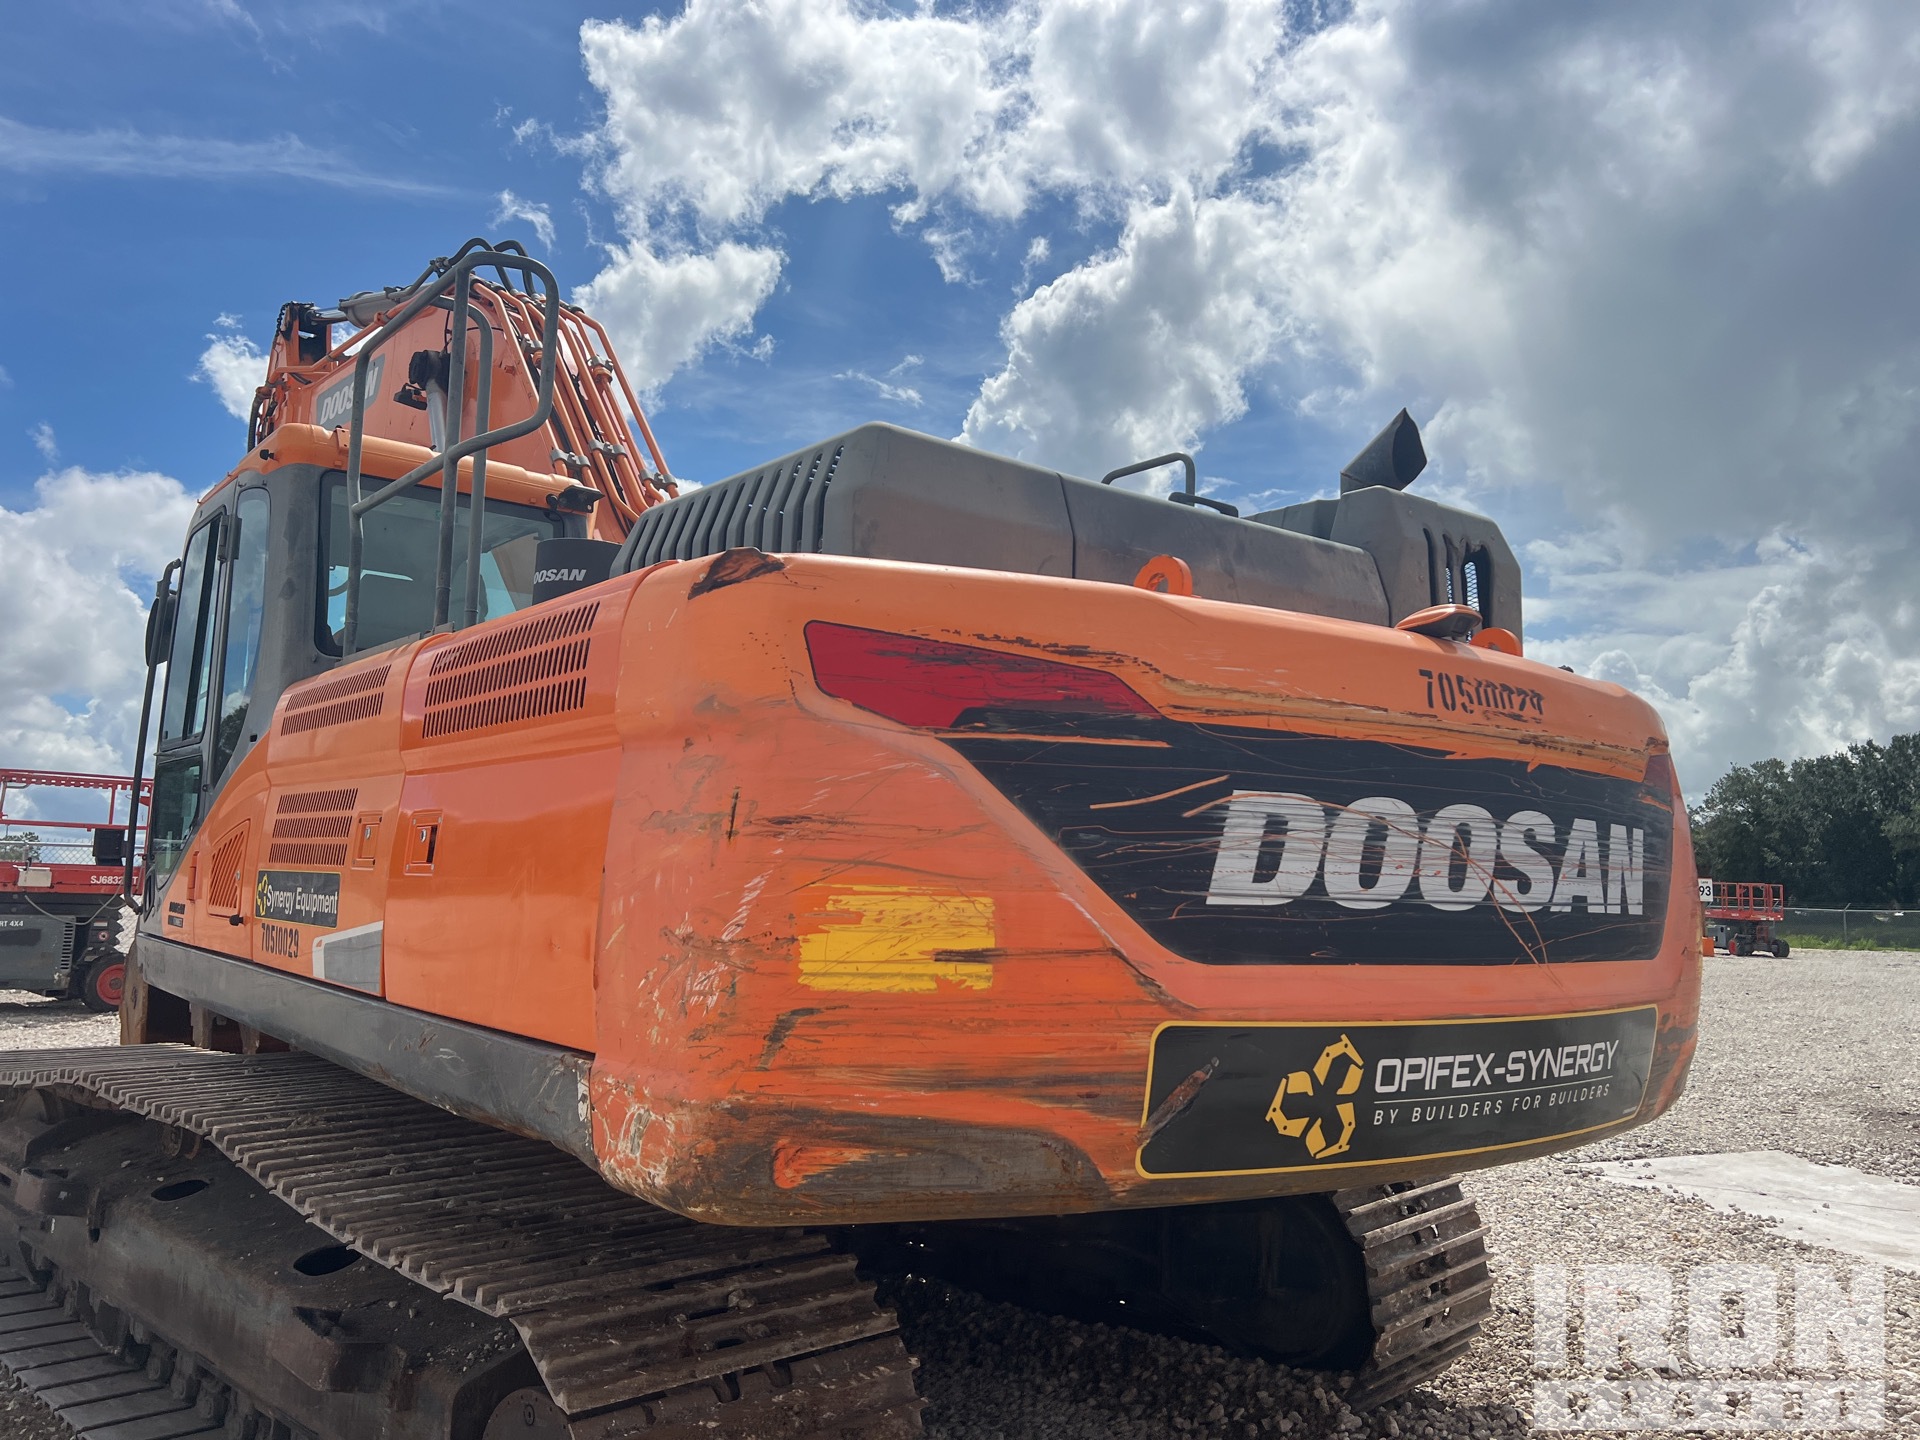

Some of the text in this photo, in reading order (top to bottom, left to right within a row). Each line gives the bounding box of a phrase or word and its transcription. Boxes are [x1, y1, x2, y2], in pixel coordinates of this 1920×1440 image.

[320, 366, 379, 425] DOOSN
[533, 568, 587, 584] OOSAN
[1205, 790, 1643, 916] DOOSAN
[90, 875, 139, 885] SJ6832T
[1699, 885, 1711, 896] 93
[266, 884, 338, 918] Synergy Equipment
[261, 922, 299, 959] 70510029
[1375, 1040, 1620, 1093] OPIFEX-SYNERGY
[1373, 1083, 1610, 1126] BY BUILDERS FOR BUILDERS
